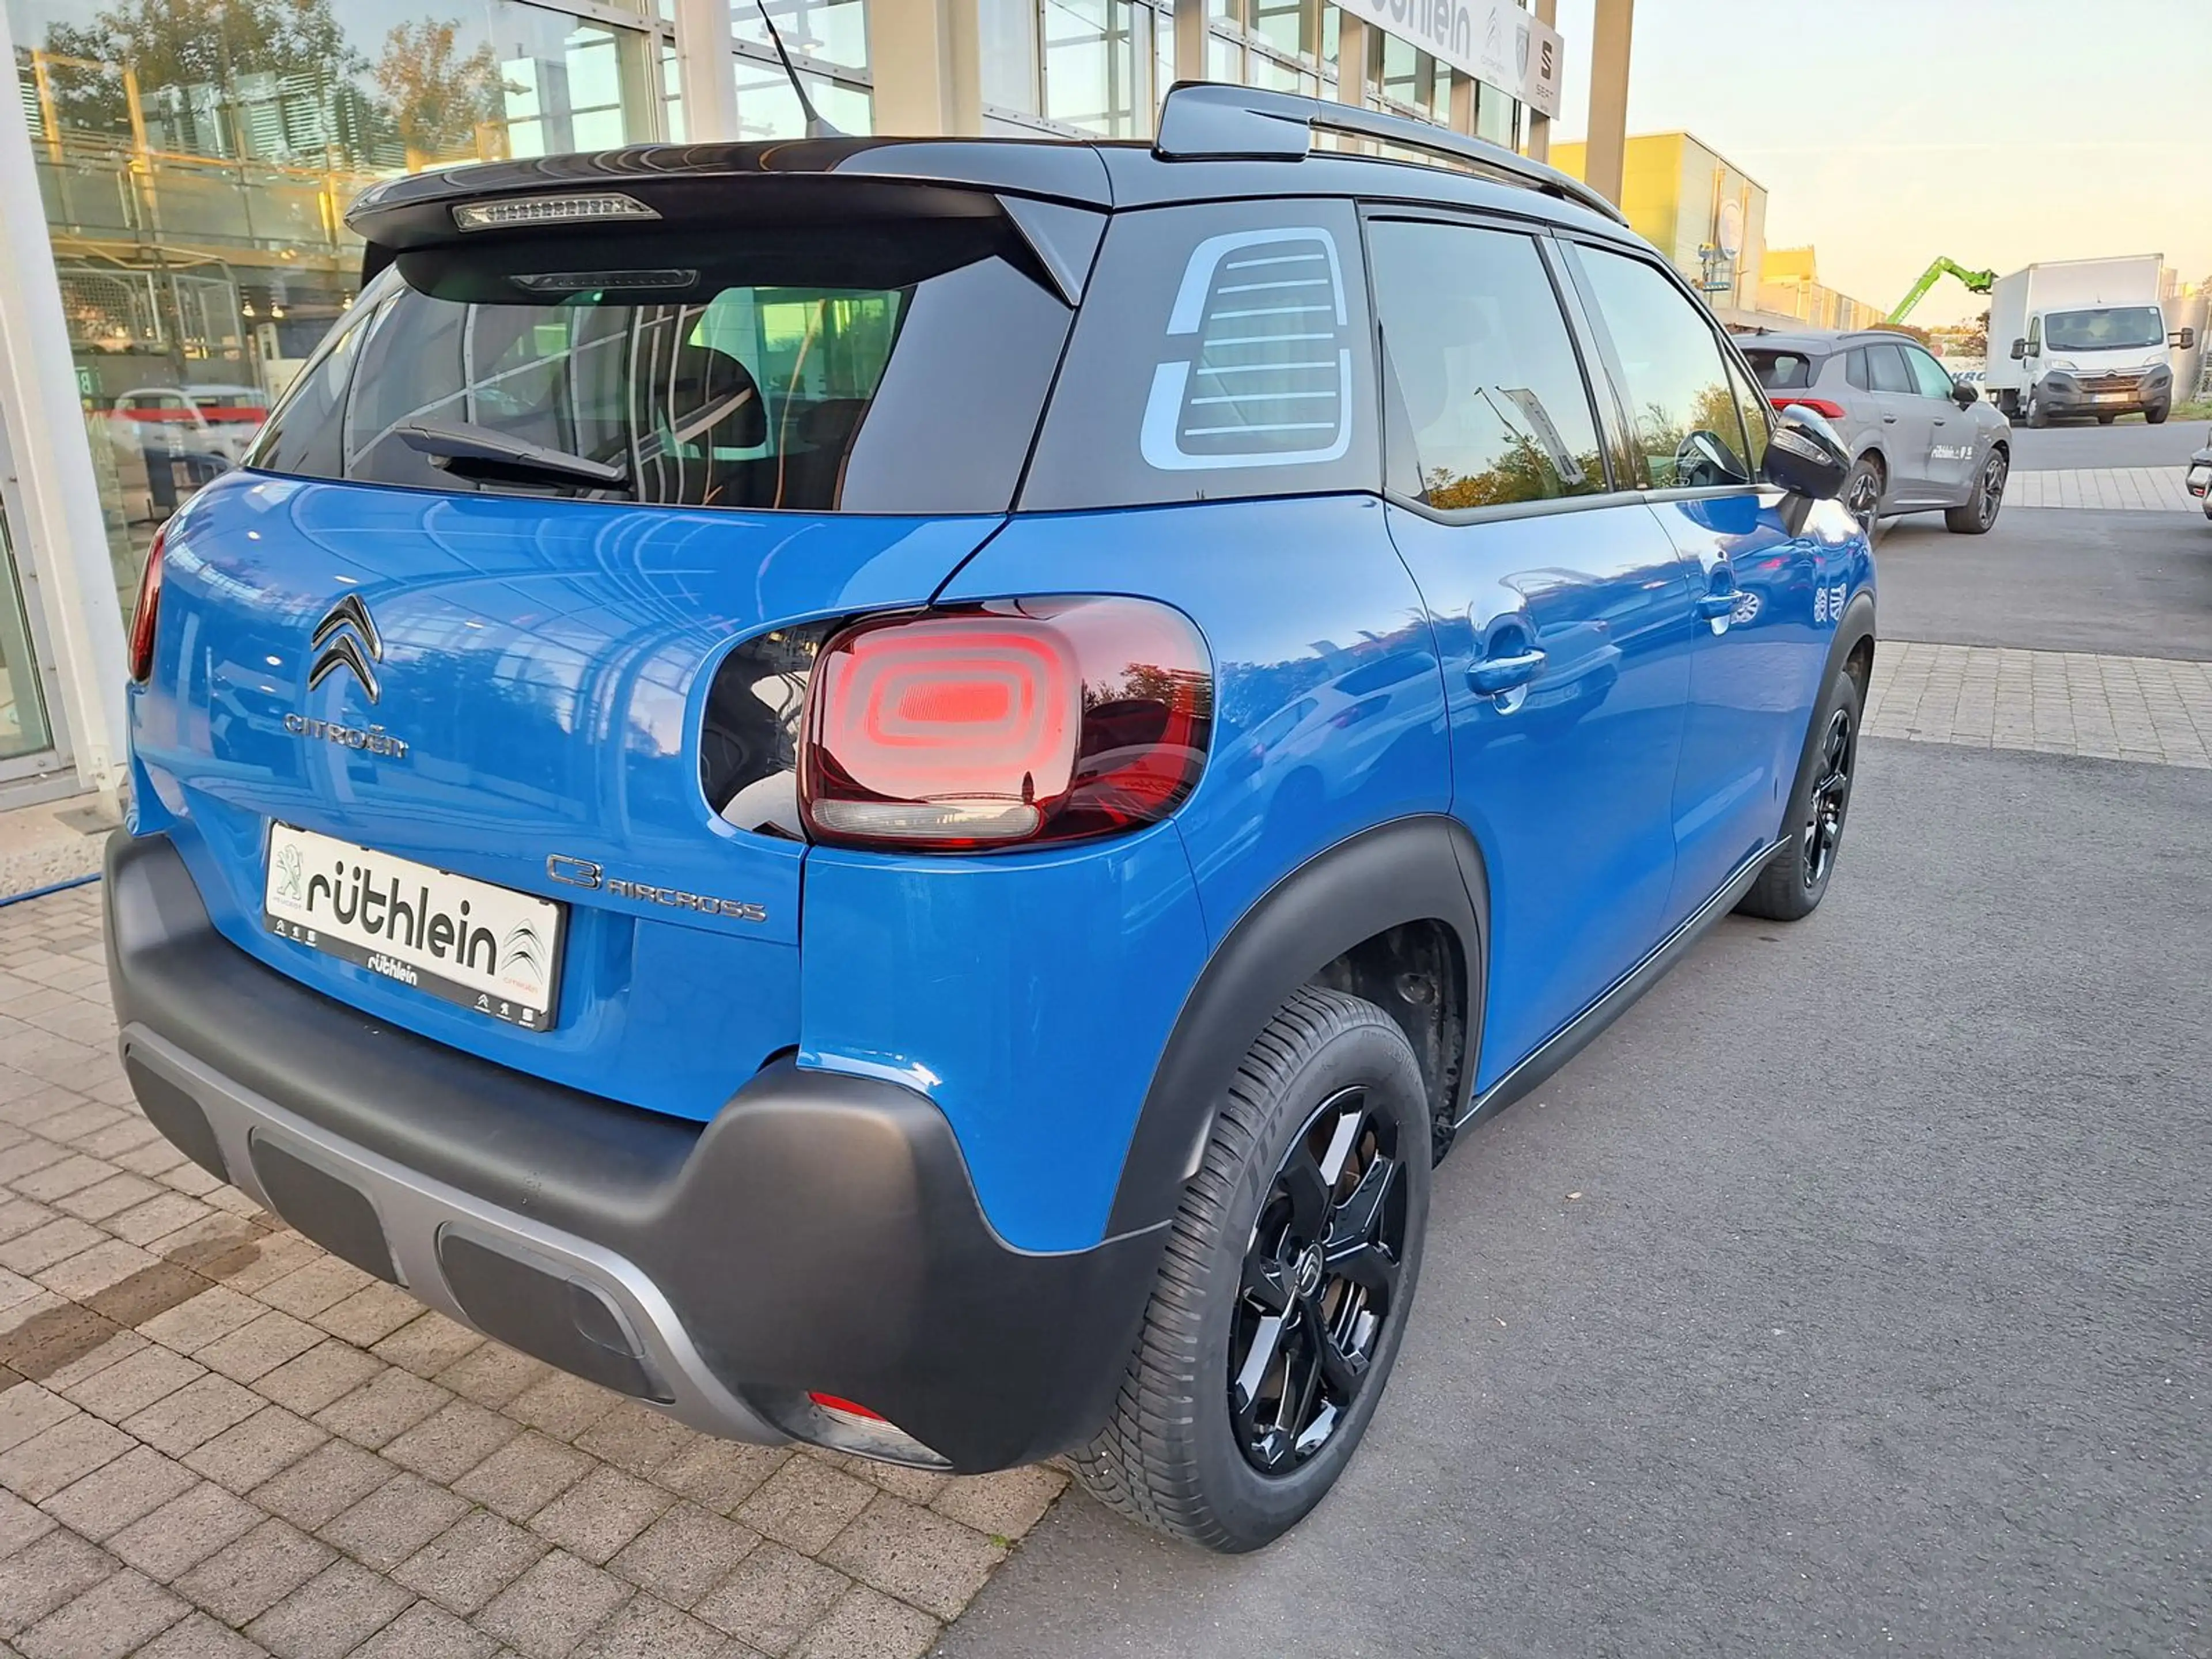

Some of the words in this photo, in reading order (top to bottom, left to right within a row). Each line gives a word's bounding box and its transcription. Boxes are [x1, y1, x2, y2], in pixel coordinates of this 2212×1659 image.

[284, 713, 410, 759] CITROËN
[547, 853, 602, 890] C3
[607, 878, 767, 922] AIRCROSS
[306, 861, 497, 976] rüthlein
[368, 953, 418, 986] rüthlein
